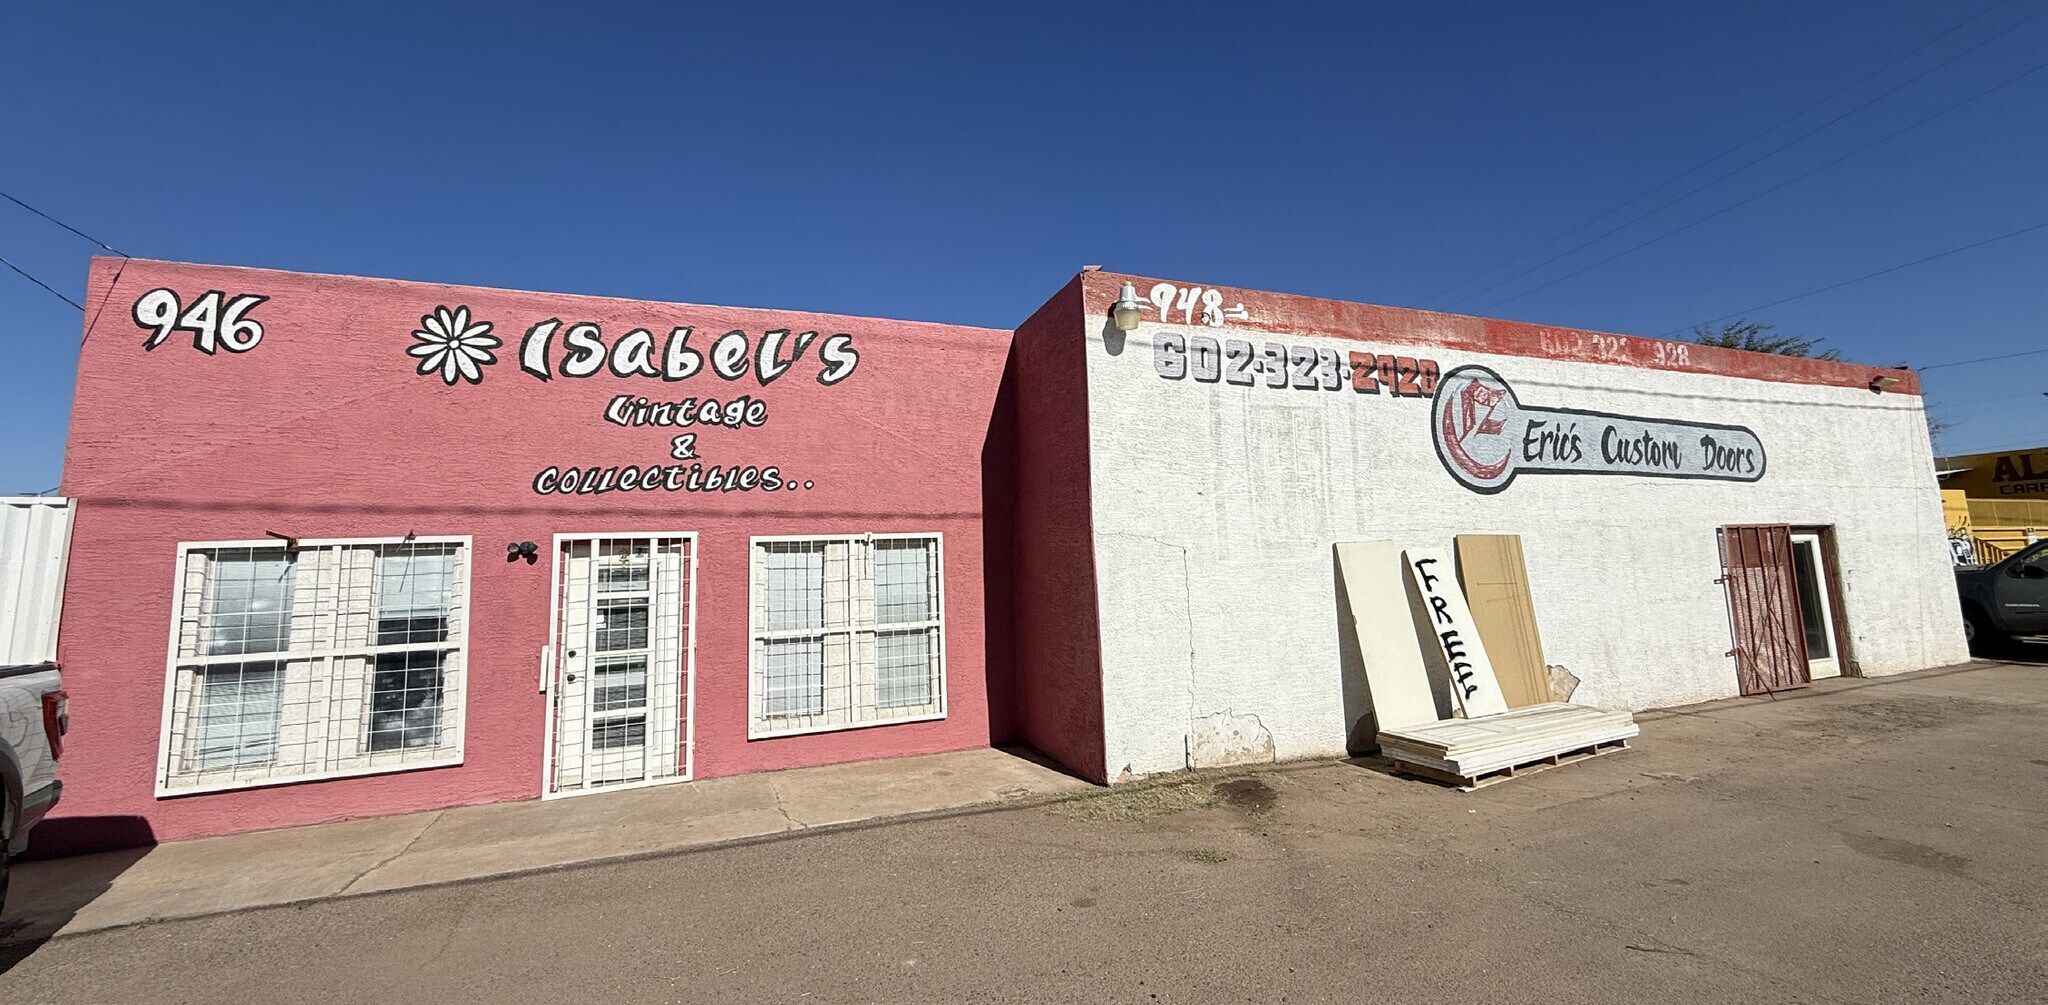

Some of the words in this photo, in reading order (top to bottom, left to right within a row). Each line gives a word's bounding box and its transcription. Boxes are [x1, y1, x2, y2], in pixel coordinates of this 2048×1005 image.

[131, 288, 270, 356] 946
[603, 395, 768, 430] Vintage
[670, 432, 701, 460] &
[1522, 419, 1583, 464] Eric's
[1601, 425, 1683, 470] Custom
[1700, 434, 1755, 473] Doors
[1414, 558, 1478, 700] FREE
